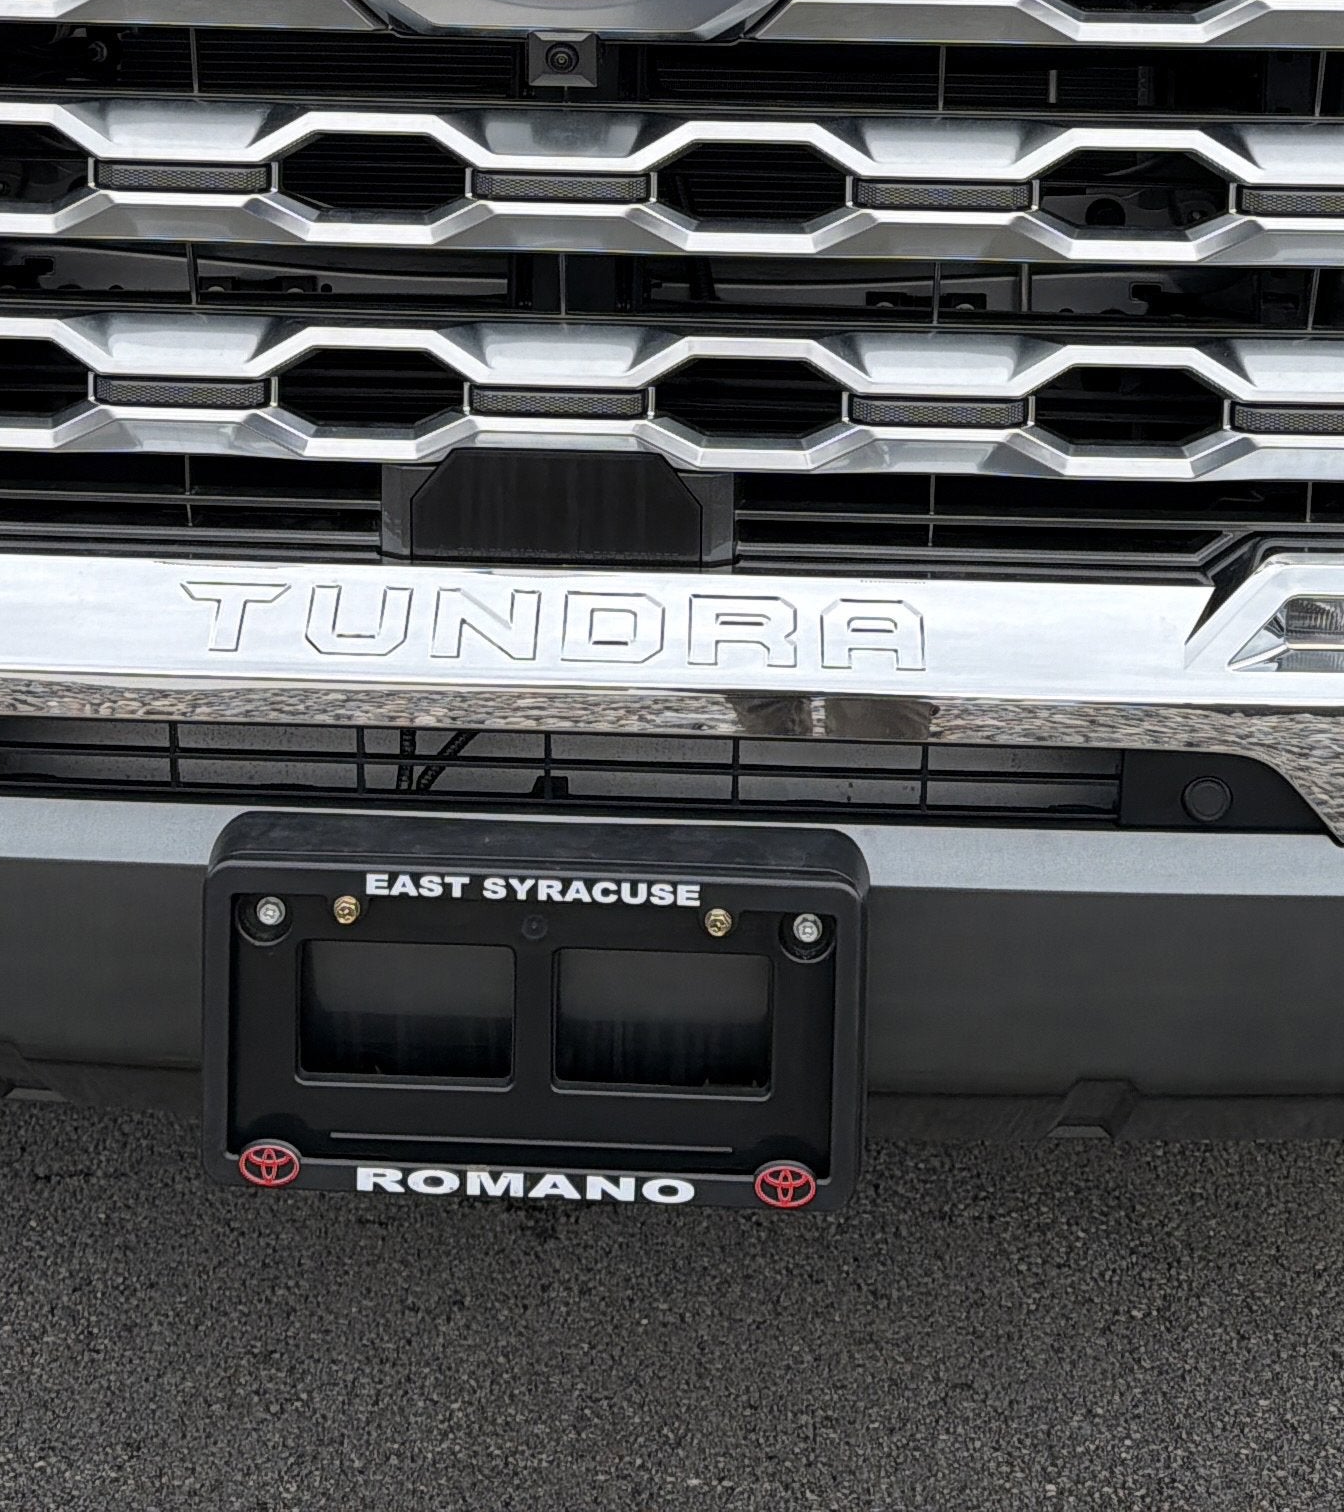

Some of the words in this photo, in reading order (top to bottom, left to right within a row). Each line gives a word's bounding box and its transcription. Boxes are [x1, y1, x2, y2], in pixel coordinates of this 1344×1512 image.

[180, 580, 927, 671] TUNDRA
[365, 873, 470, 898] EAST
[482, 877, 702, 907] SYRACUSE
[356, 1166, 695, 1204] ROMANO
